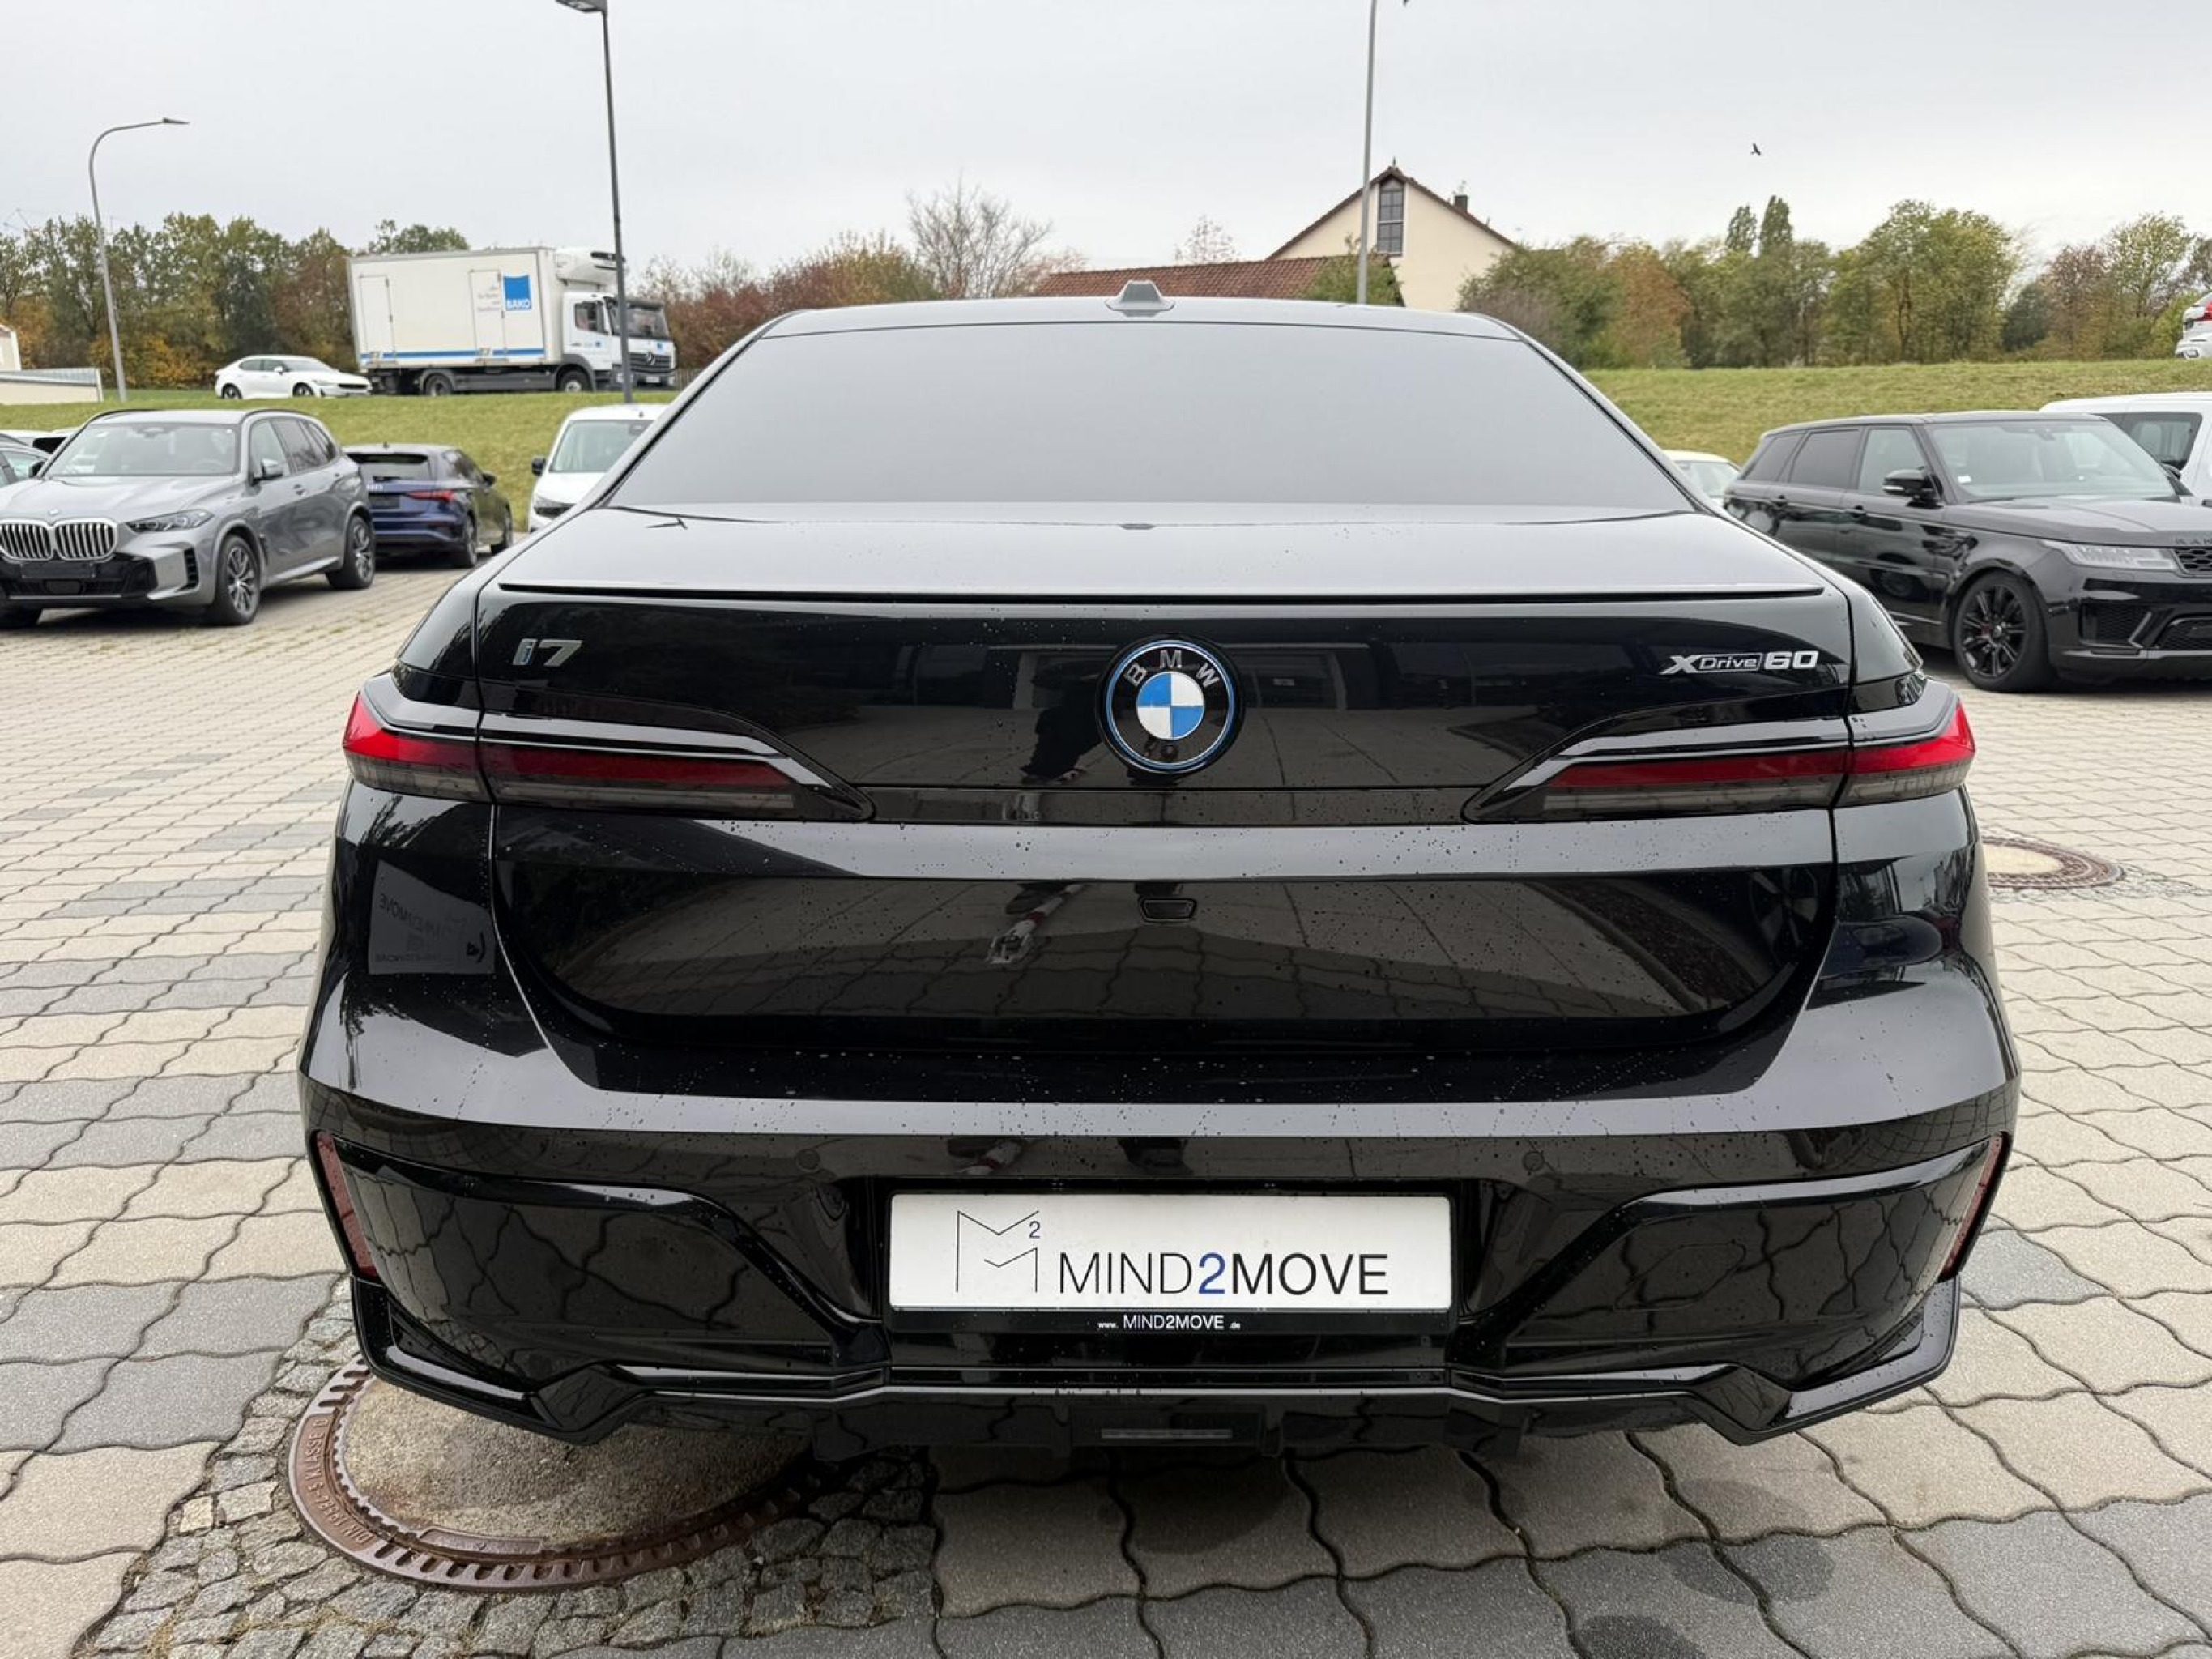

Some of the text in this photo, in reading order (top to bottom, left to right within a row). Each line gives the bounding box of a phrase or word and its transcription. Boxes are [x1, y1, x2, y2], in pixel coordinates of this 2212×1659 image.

[506, 298, 531, 310] BAKO
[512, 638, 583, 667] i7
[1764, 650, 1819, 670] 60
[1123, 649, 1221, 689] BMW
[1059, 1252, 1389, 1296] MIND2MOVE
[1123, 1314, 1225, 1331] MIND2MOVE
[304, 1431, 326, 1482] KLASSE
[343, 1524, 377, 1545] DIN
